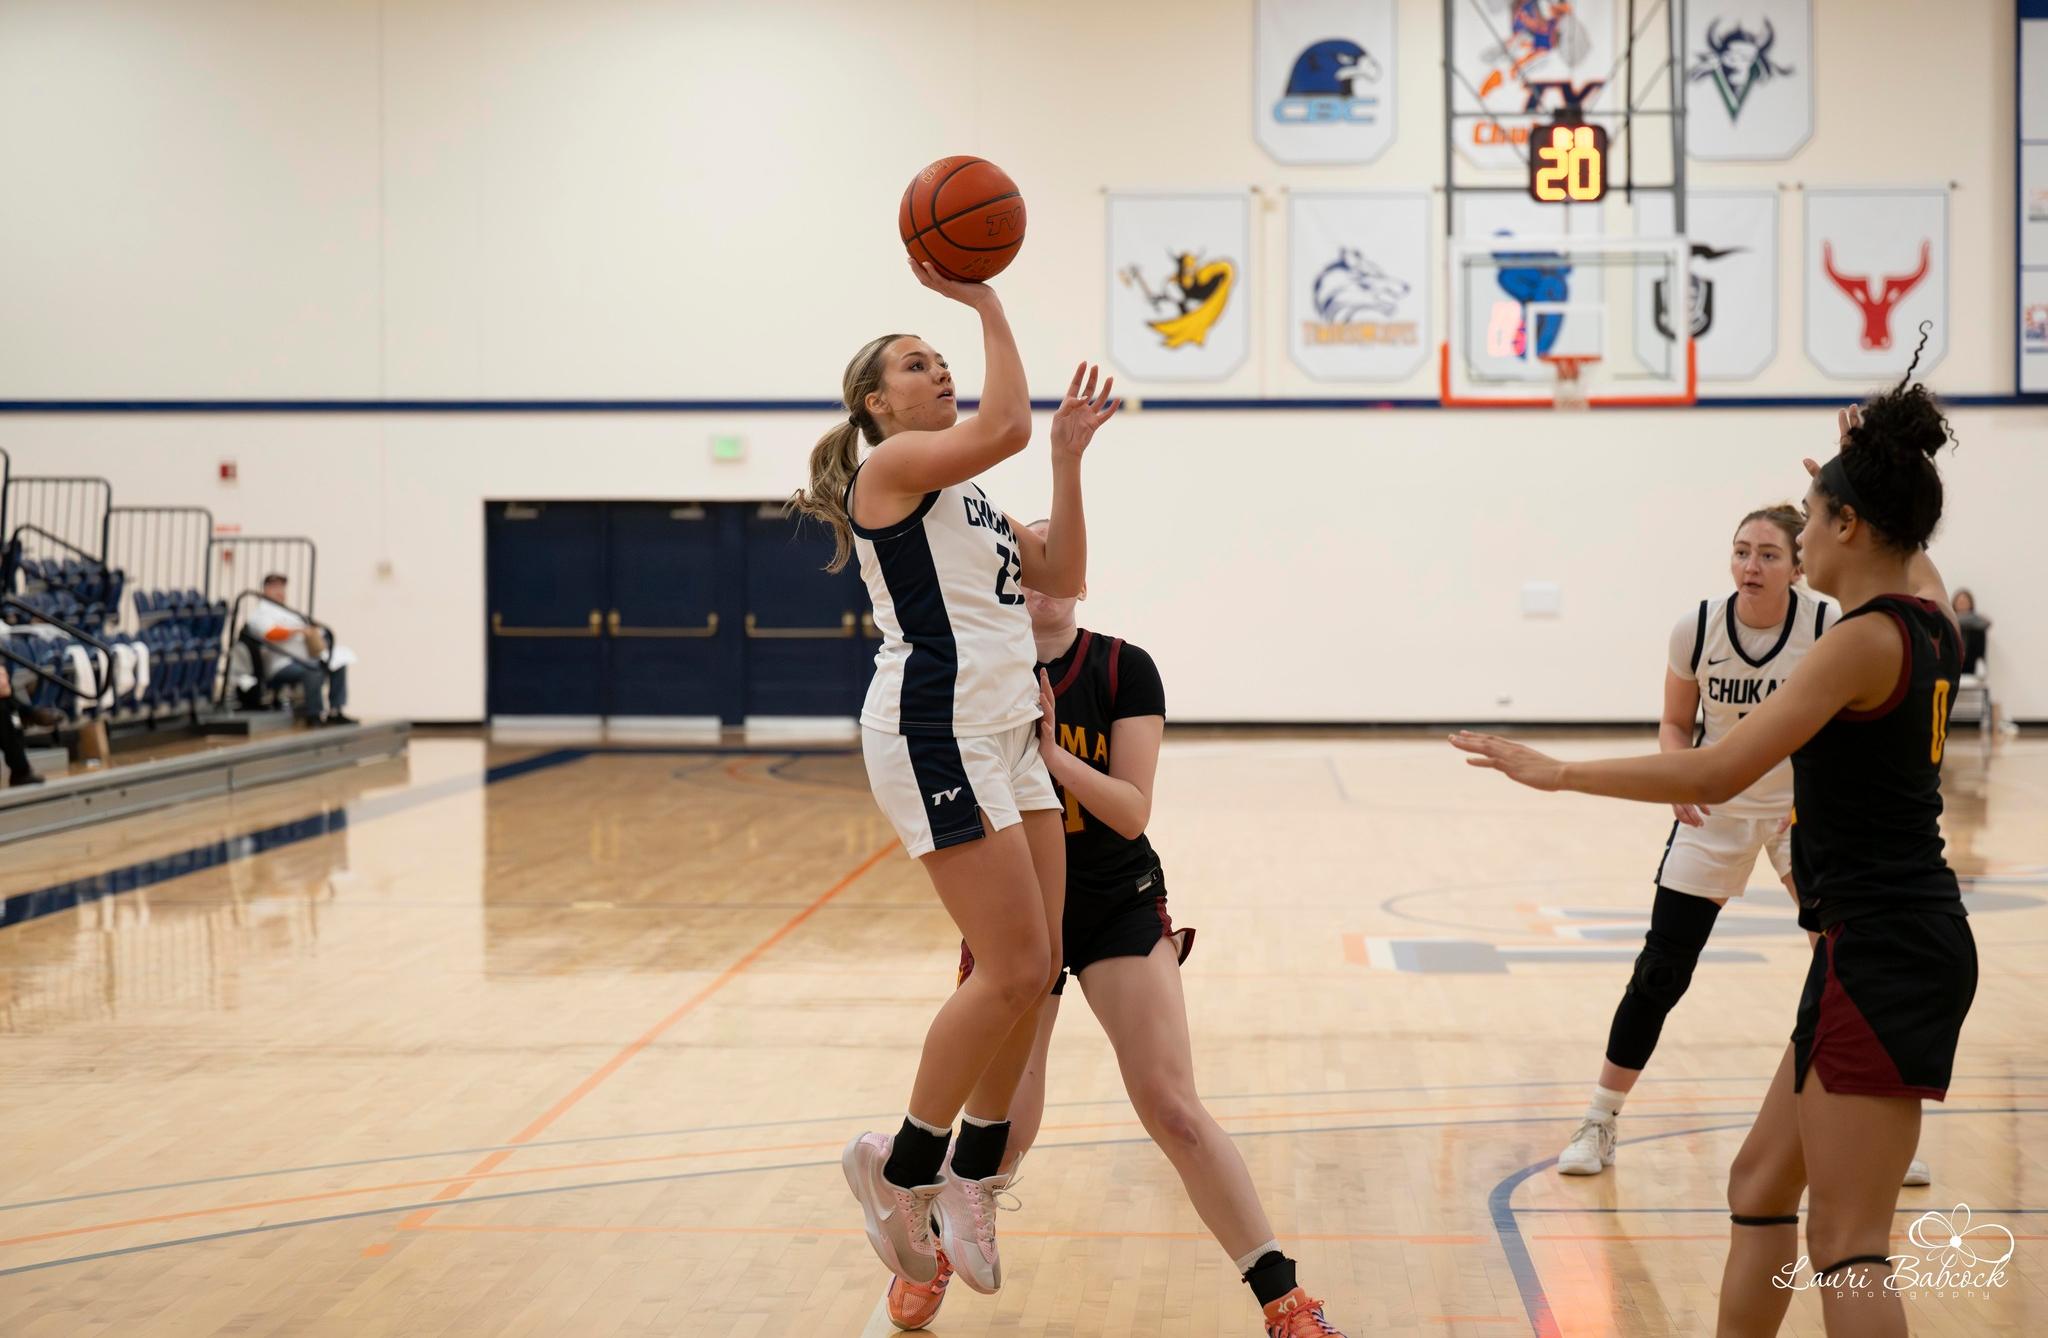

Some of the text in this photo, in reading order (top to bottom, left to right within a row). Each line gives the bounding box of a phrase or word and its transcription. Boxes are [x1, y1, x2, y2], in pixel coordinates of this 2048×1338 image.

[1273, 97, 1377, 124] CBC
[1473, 120, 1537, 144] Chu
[1536, 147, 1601, 200] 20
[963, 496, 1017, 545] CHUK
[1708, 677, 1786, 704] CHUKA
[1930, 679, 1951, 765] 0
[1059, 723, 1109, 767] MA
[931, 786, 962, 806] TV
